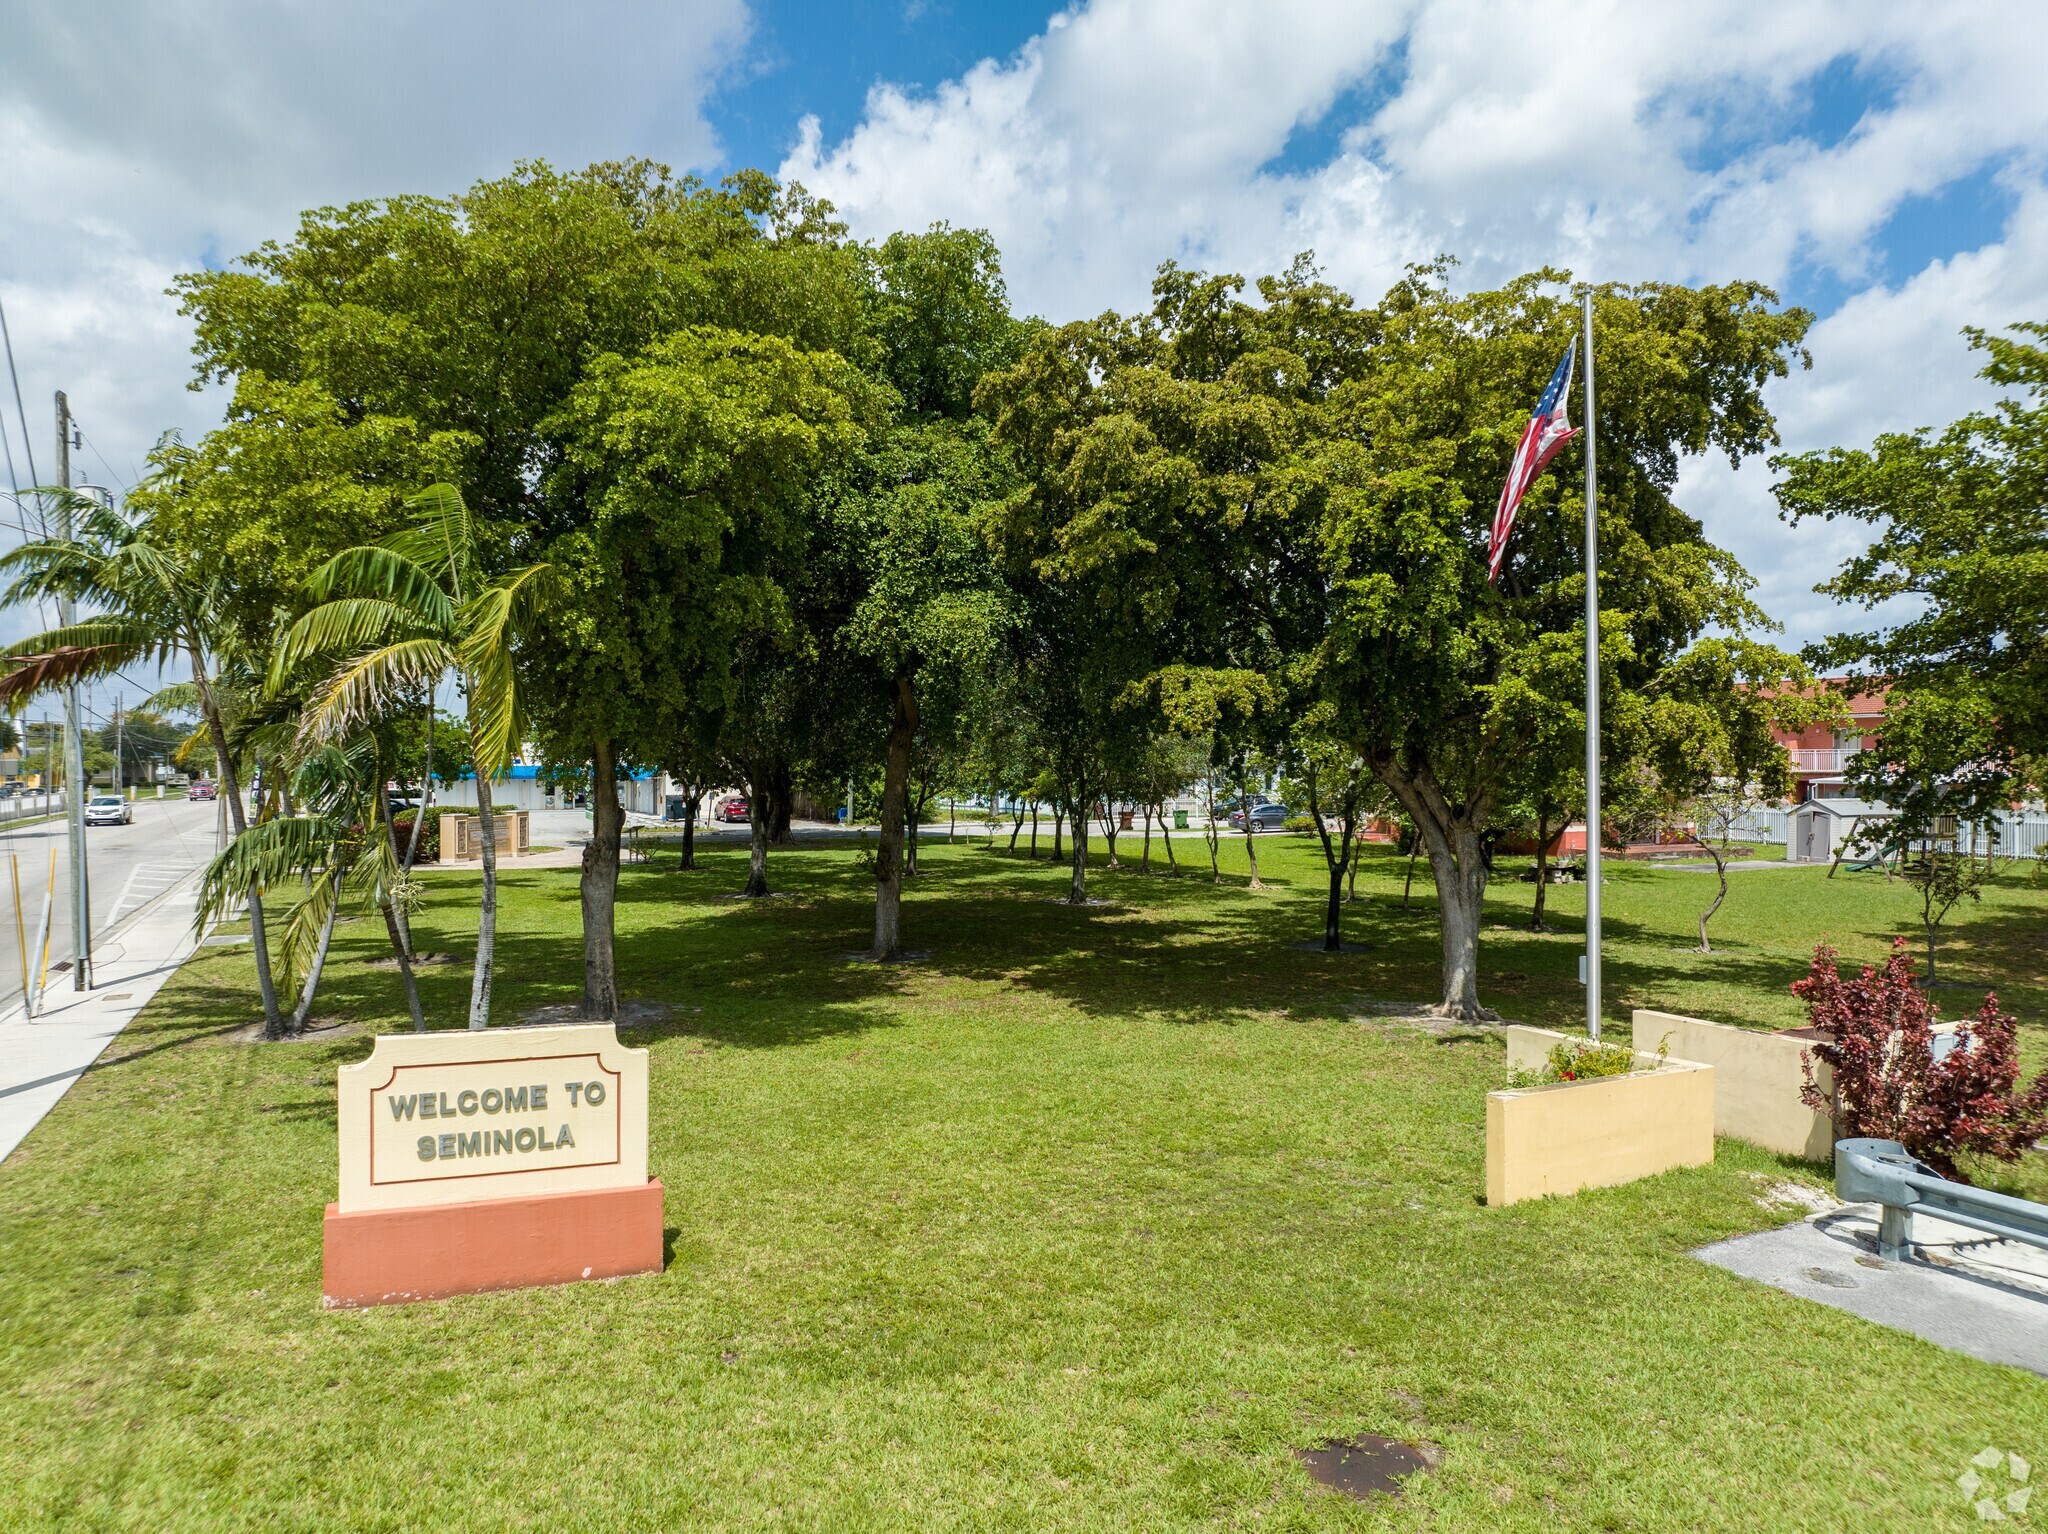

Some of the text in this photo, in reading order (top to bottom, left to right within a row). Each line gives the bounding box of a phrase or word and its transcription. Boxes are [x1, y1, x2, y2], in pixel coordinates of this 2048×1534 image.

[388, 1080, 606, 1119] WELCOME TO
[416, 1124, 576, 1160] SEMINOLA
